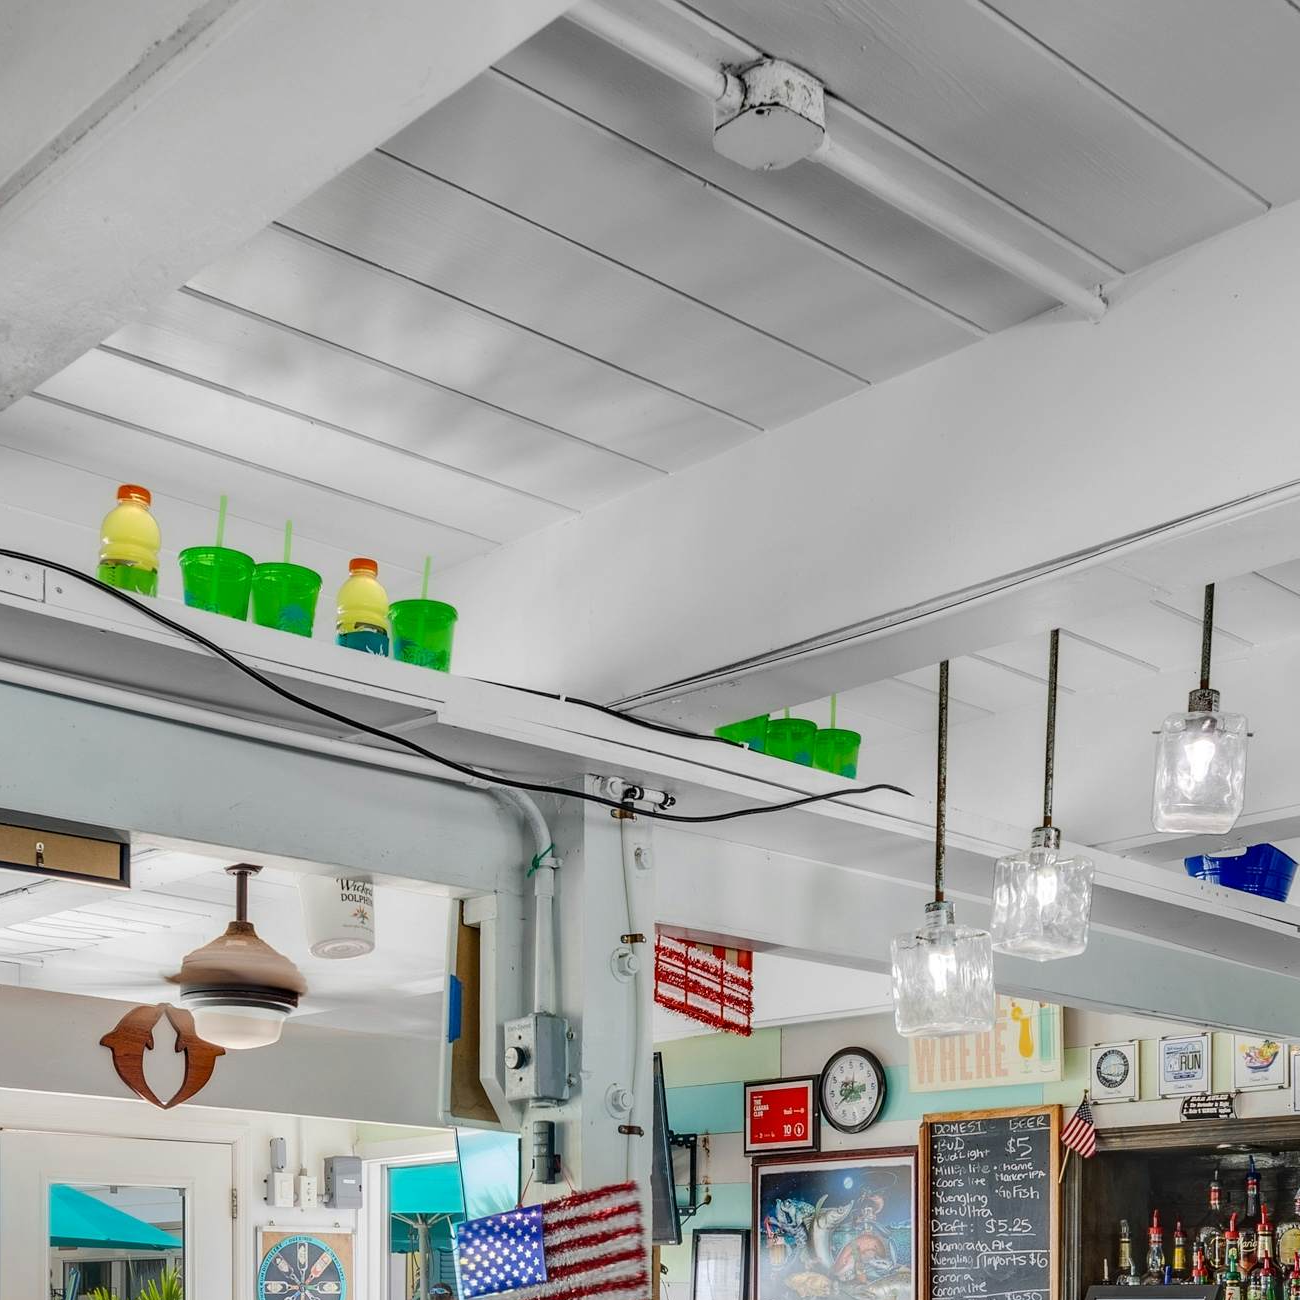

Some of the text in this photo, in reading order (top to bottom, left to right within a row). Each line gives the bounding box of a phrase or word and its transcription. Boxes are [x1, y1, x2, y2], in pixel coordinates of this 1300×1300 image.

[914, 1022, 1009, 1084] WHERE
[1180, 1054, 1201, 1071] RUN
[1005, 1137, 1032, 1158] $5
[936, 1179, 964, 1188] Coors
[985, 1218, 1032, 1233] $5.25
[992, 1240, 1012, 1251] Ale
[1029, 1253, 1048, 1268] $6
